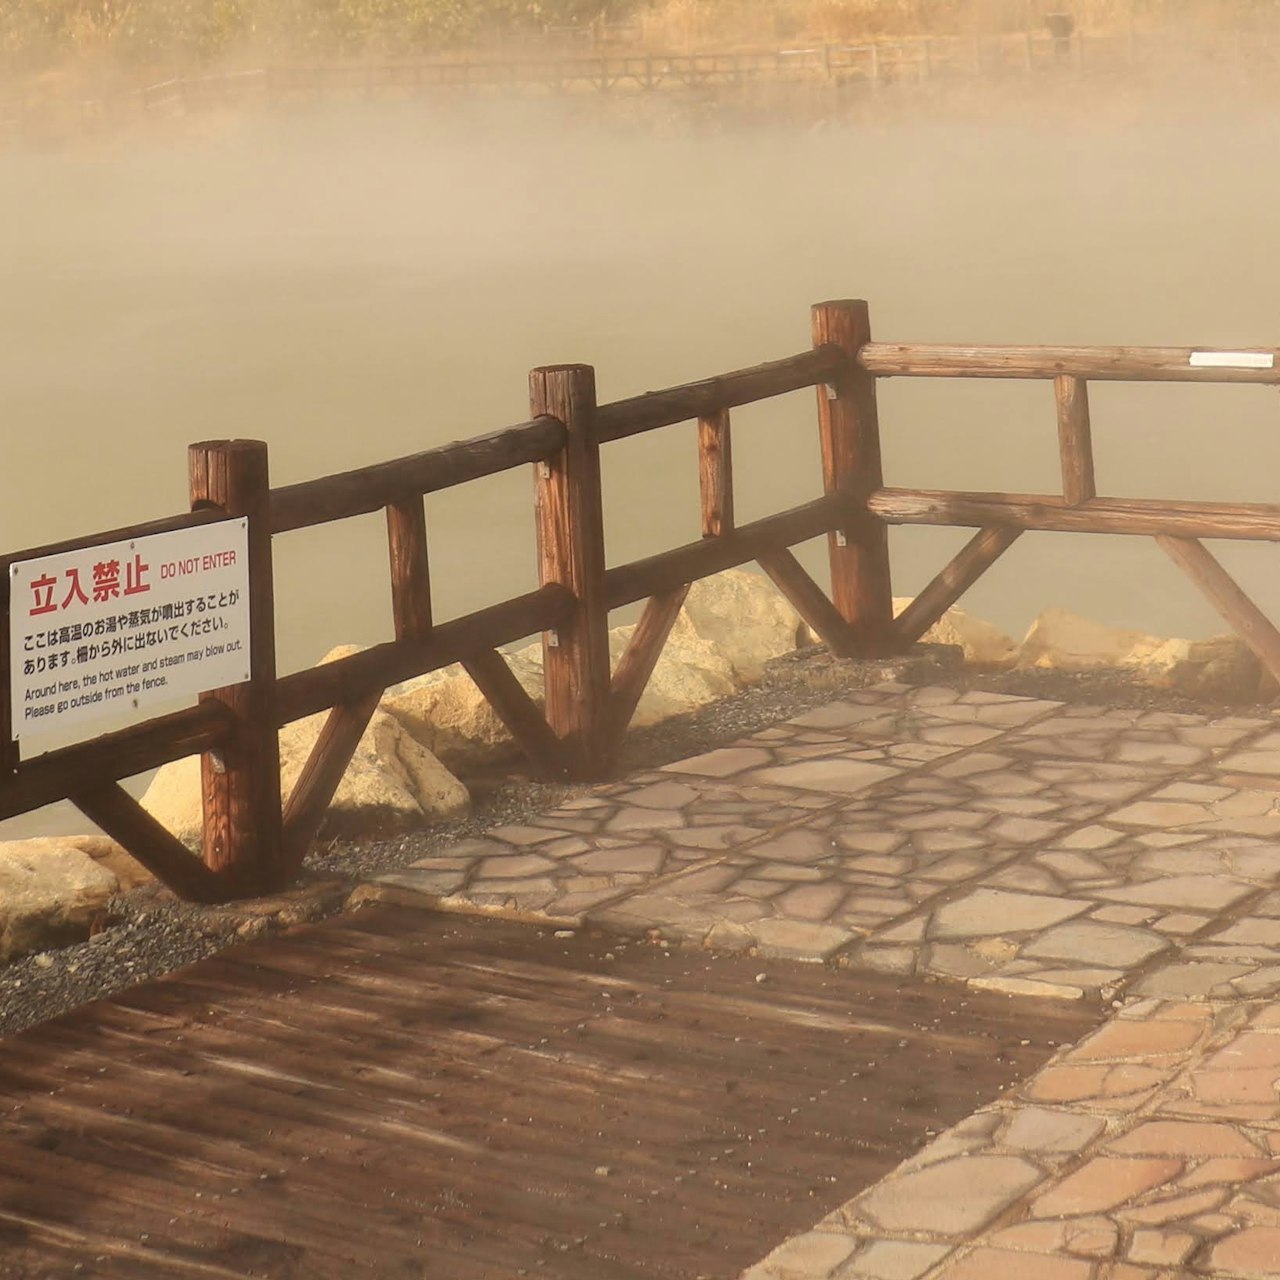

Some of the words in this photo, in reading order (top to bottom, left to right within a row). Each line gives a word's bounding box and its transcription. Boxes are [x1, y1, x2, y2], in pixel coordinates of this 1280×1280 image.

[29, 554, 150, 616] 立入禁止
[160, 562, 176, 579] DO
[179, 557, 200, 575] NOT
[202, 550, 236, 570] ENTER
[24, 590, 239, 651] ここは高温のお湯や蒸気が噴出することが
[24, 617, 228, 675] あります。柵から外に出ないでください。
[25, 682, 56, 701] Around
[59, 679, 80, 691] here,
[83, 675, 97, 687] the
[99, 670, 113, 682] hot
[116, 665, 140, 678] water
[142, 657, 157, 672] and
[159, 653, 185, 668] steam
[187, 649, 204, 662] may
[206, 644, 224, 656] blow
[226, 640, 242, 653] out.
[25, 702, 55, 720] Please
[58, 699, 68, 713] go
[70, 691, 103, 709] outside
[105, 686, 124, 699] from
[126, 682, 140, 694] the
[142, 676, 167, 689] fence.
